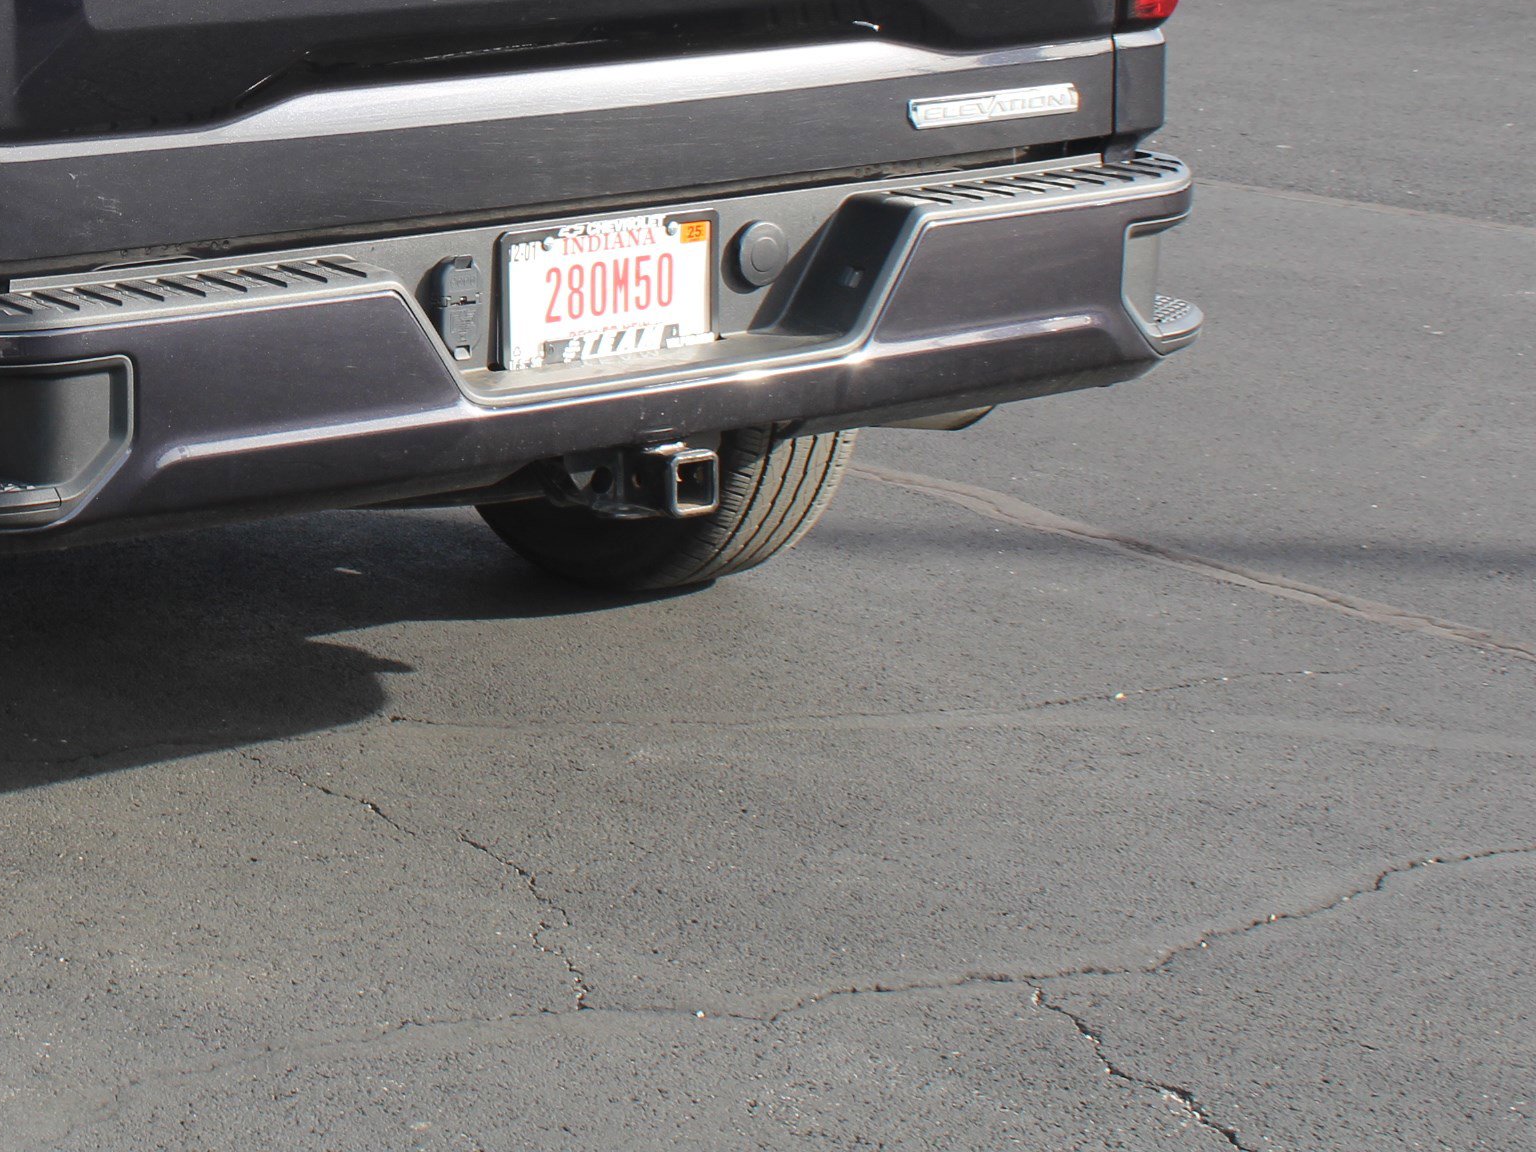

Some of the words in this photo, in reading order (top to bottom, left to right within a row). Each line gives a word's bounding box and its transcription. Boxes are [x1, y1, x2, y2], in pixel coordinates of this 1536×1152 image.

[922, 92, 1067, 123] ELEVATION
[562, 227, 657, 256] INDIANA
[687, 225, 702, 239] 25
[544, 252, 673, 324] 280M50
[580, 324, 666, 360] TEAM
